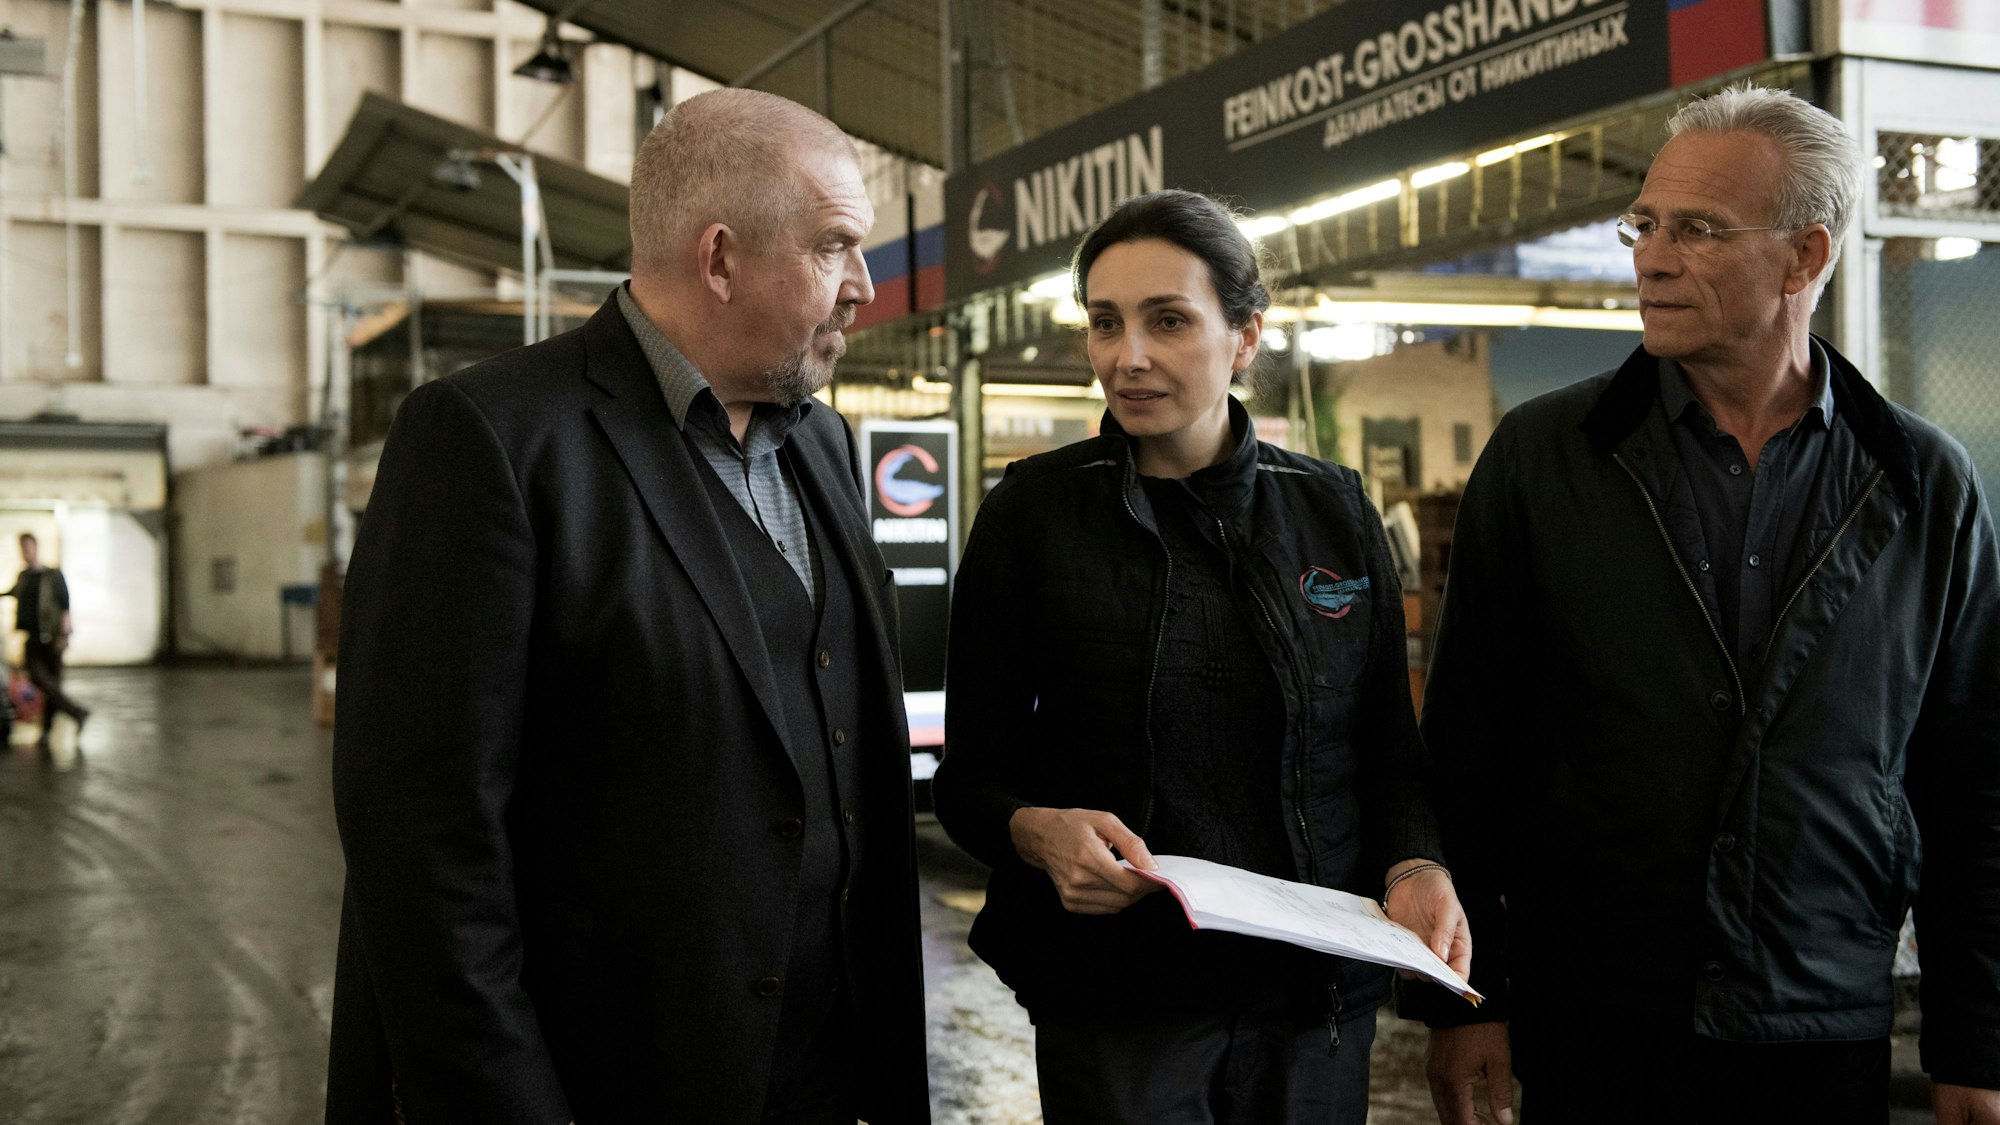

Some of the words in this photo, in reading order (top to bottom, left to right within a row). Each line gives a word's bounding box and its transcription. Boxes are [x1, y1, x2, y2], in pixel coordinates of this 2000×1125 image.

[1223, 0, 1602, 141] FEINKOST-GROSSHAN
[1447, 65, 1478, 102] ОТ
[1480, 11, 1630, 92] НИКИТИНЫХ
[1014, 124, 1165, 251] NIKITIN
